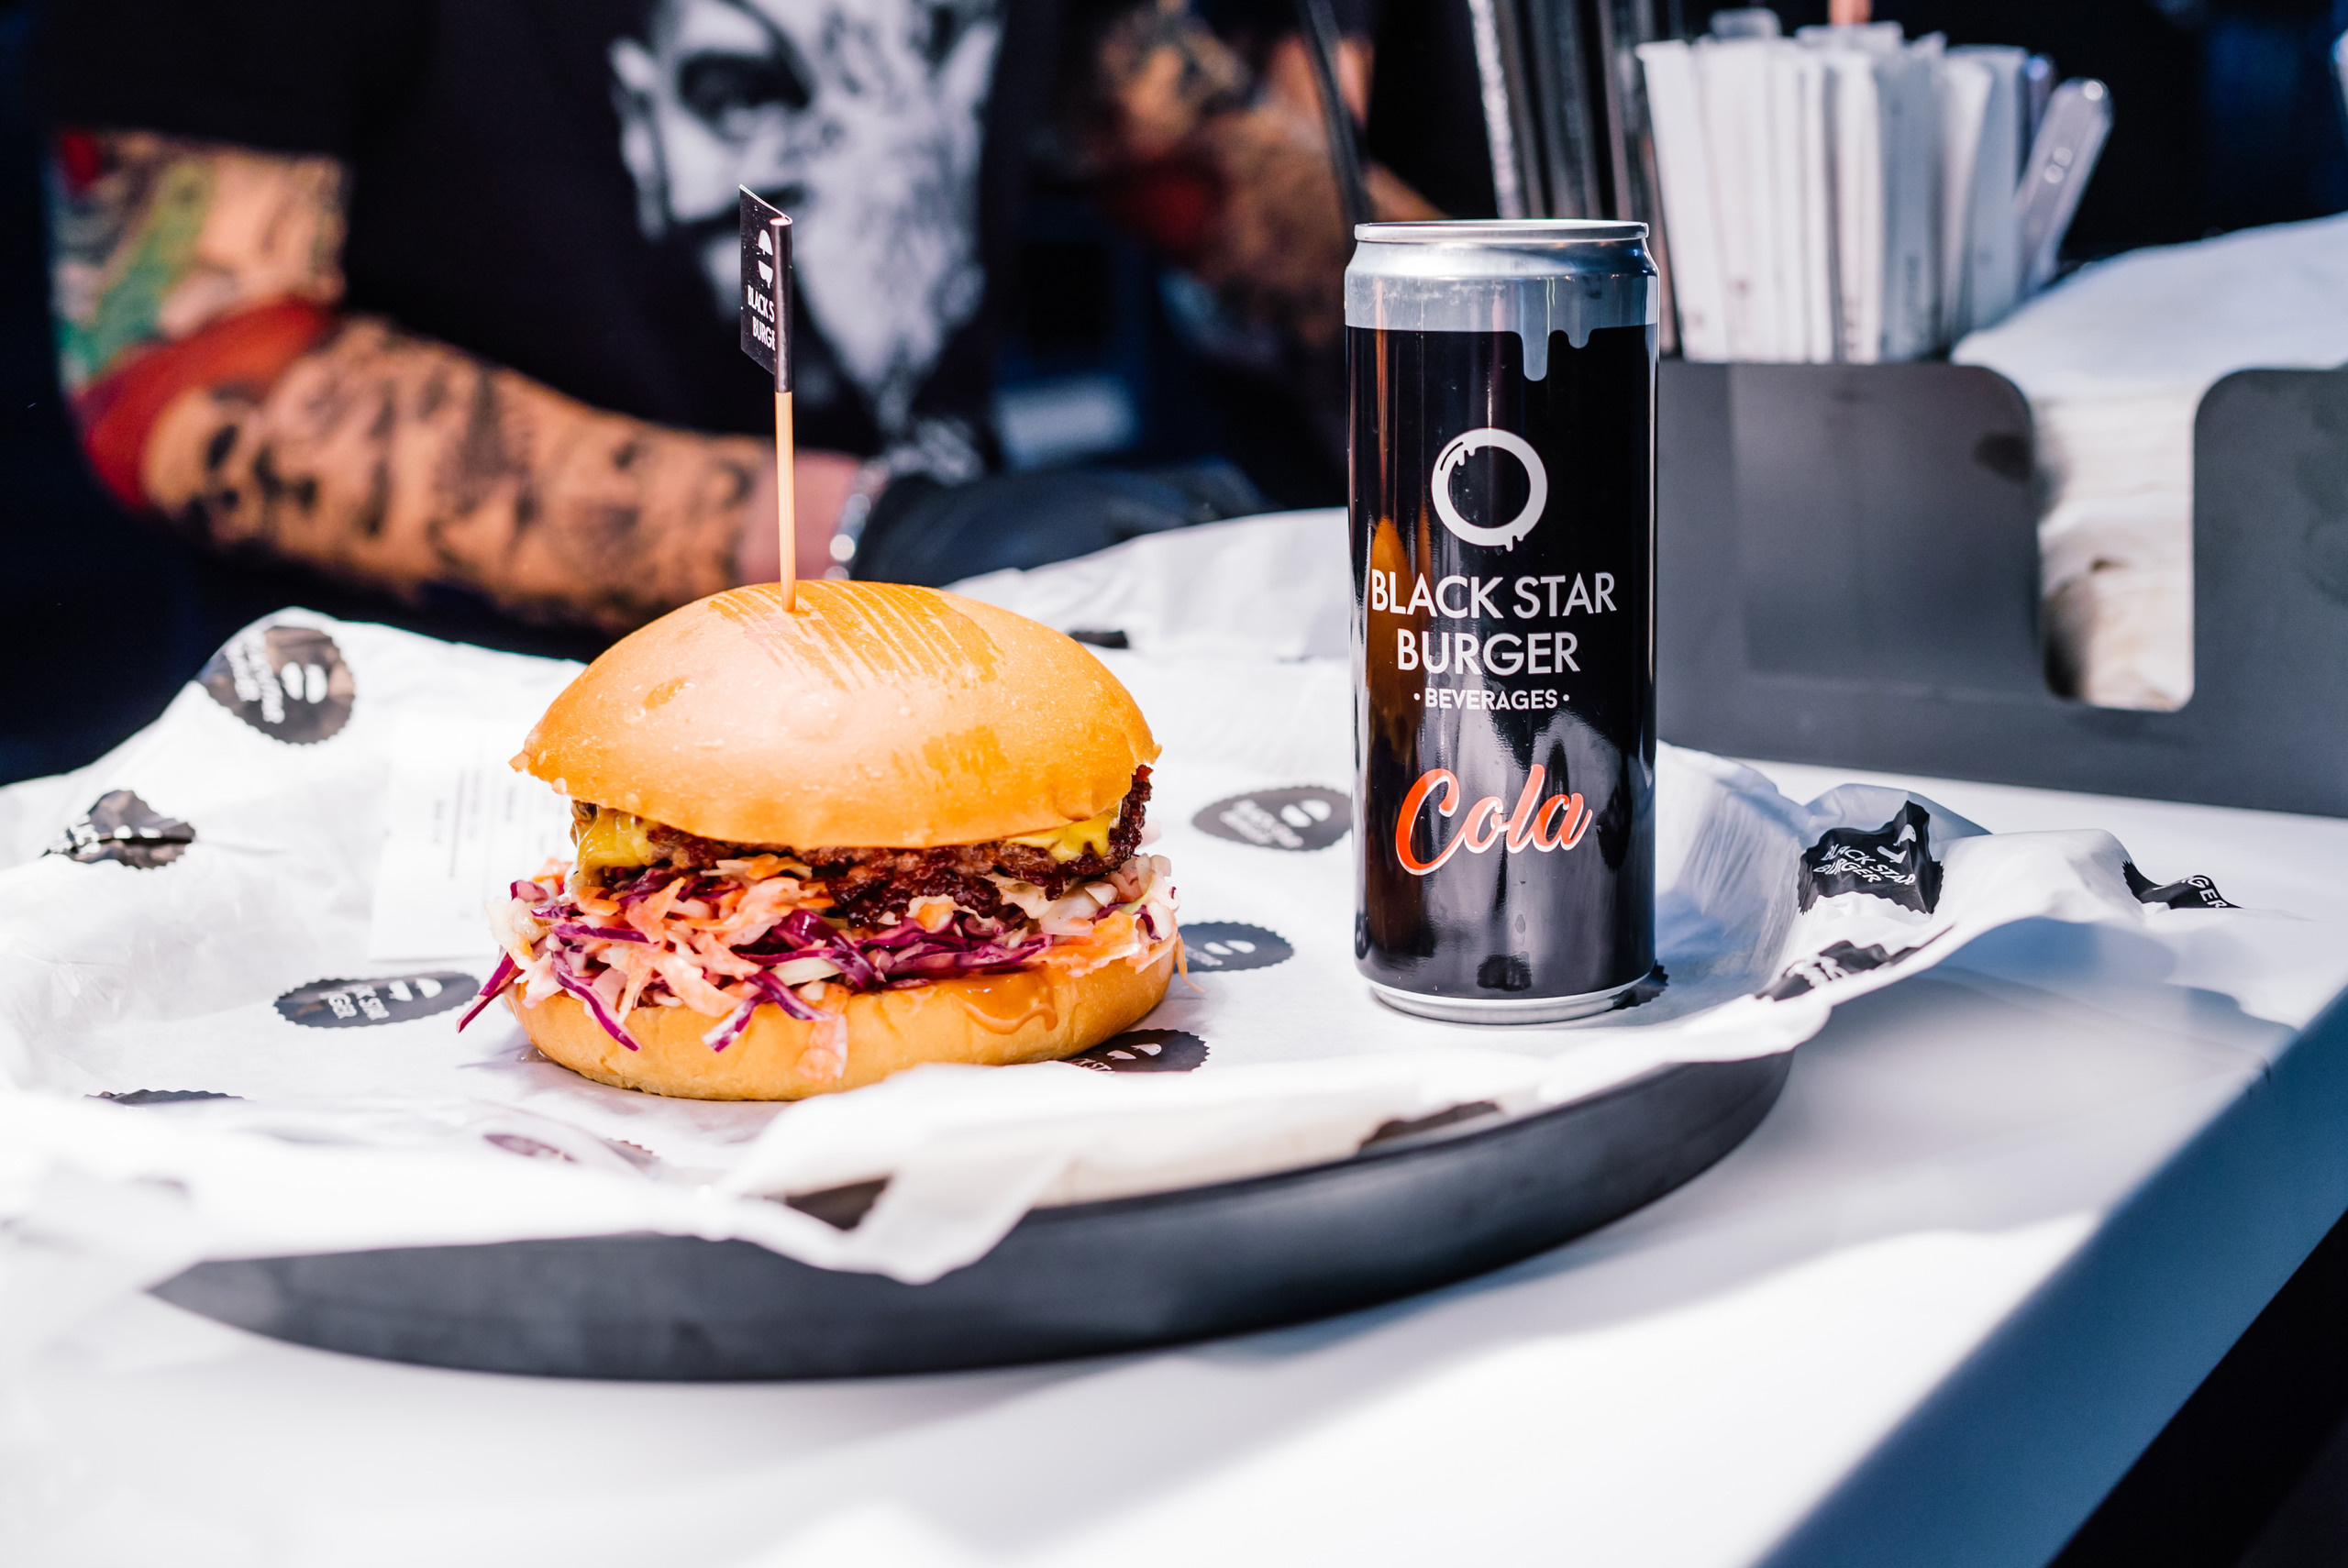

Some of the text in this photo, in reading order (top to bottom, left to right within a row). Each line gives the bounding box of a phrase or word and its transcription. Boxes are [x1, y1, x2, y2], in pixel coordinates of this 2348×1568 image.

[748, 284, 769, 319] BLACK
[752, 315, 776, 351] BURGE
[1371, 569, 1618, 620] BLACK STAR
[1397, 628, 1581, 676] BURGER
[1424, 688, 1558, 711] BEVERAGES
[1395, 763, 1593, 876] Cola
[1812, 857, 1882, 883] BURGER
[1820, 844, 1917, 886] BLACK STAR
[2181, 875, 2229, 909] GER
